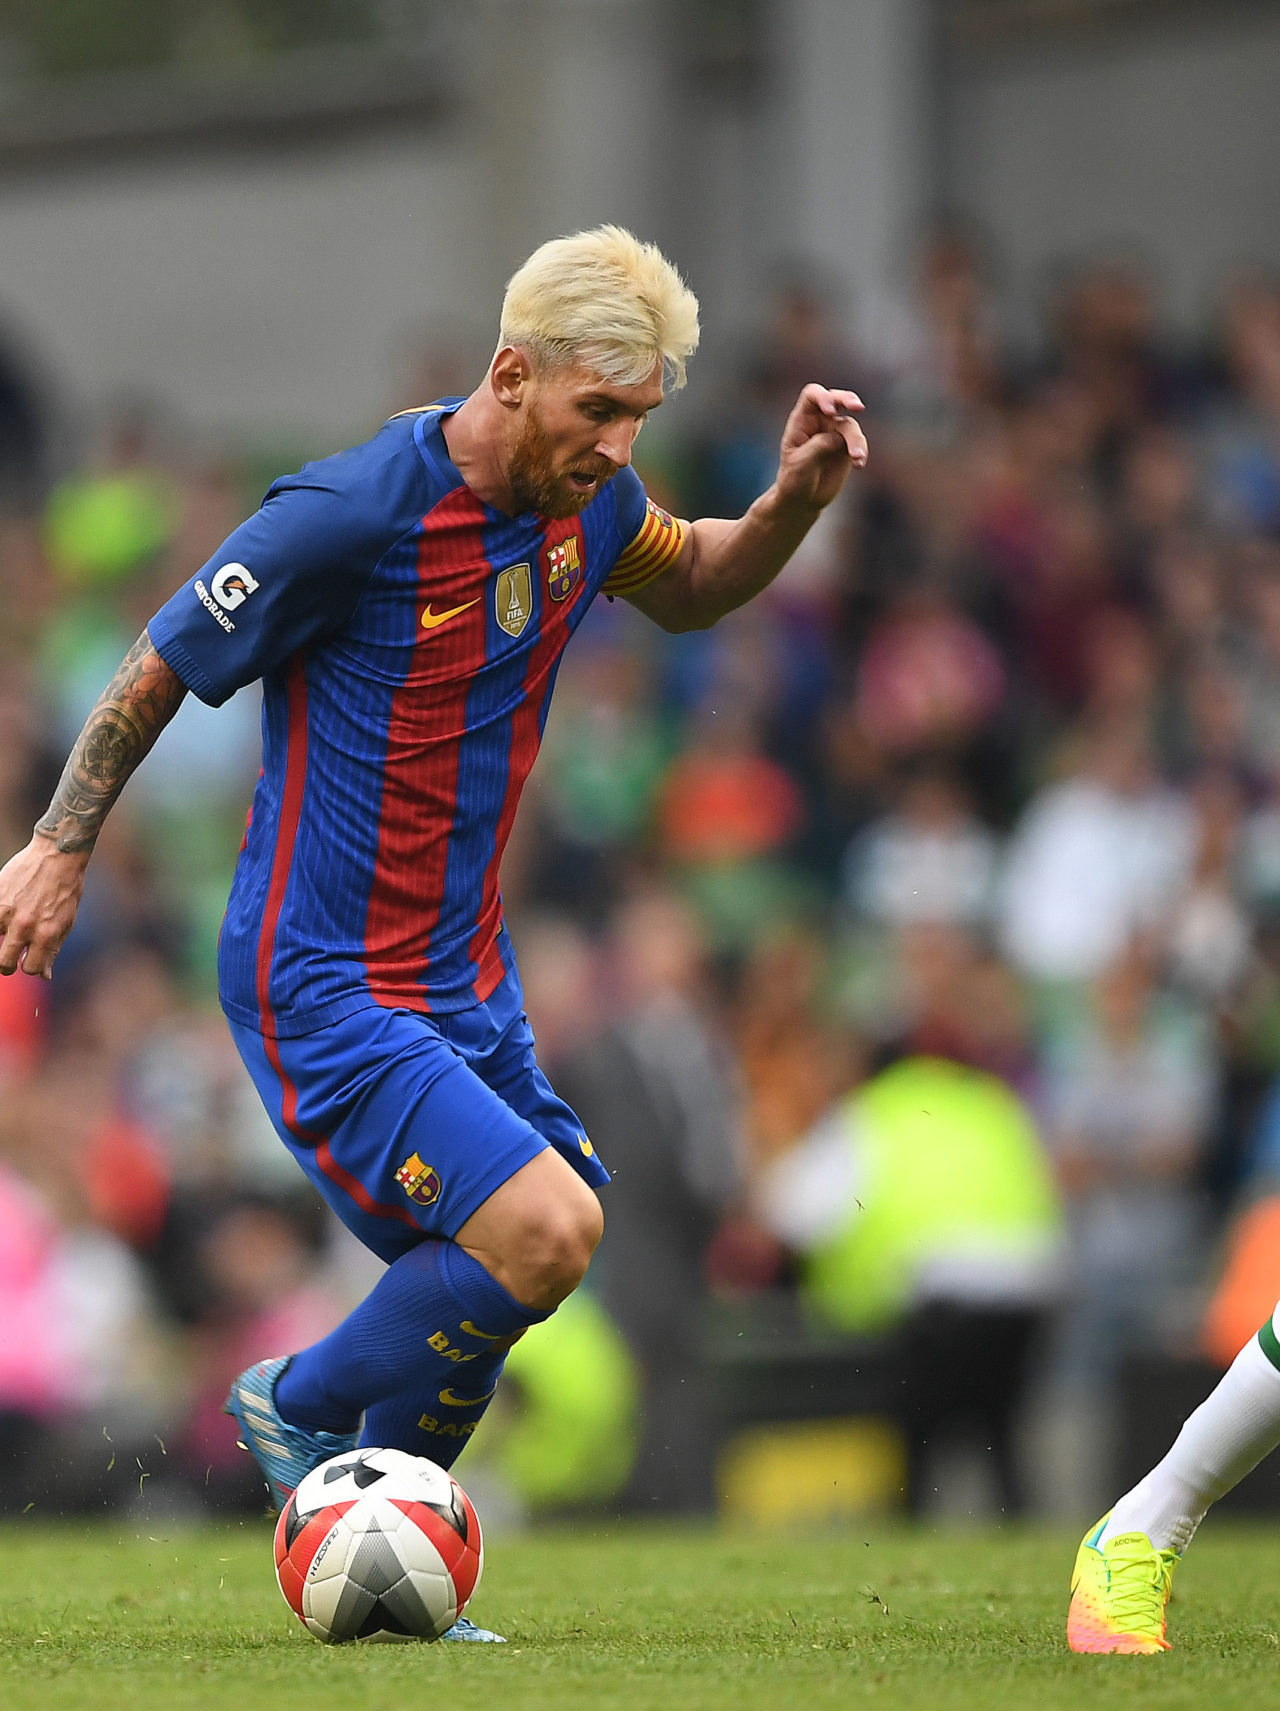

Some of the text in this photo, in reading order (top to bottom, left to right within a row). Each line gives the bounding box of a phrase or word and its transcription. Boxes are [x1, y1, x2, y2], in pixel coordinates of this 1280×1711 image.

[194, 580, 236, 633] GATORADE
[211, 562, 260, 611] G
[506, 608, 524, 621] FIFA
